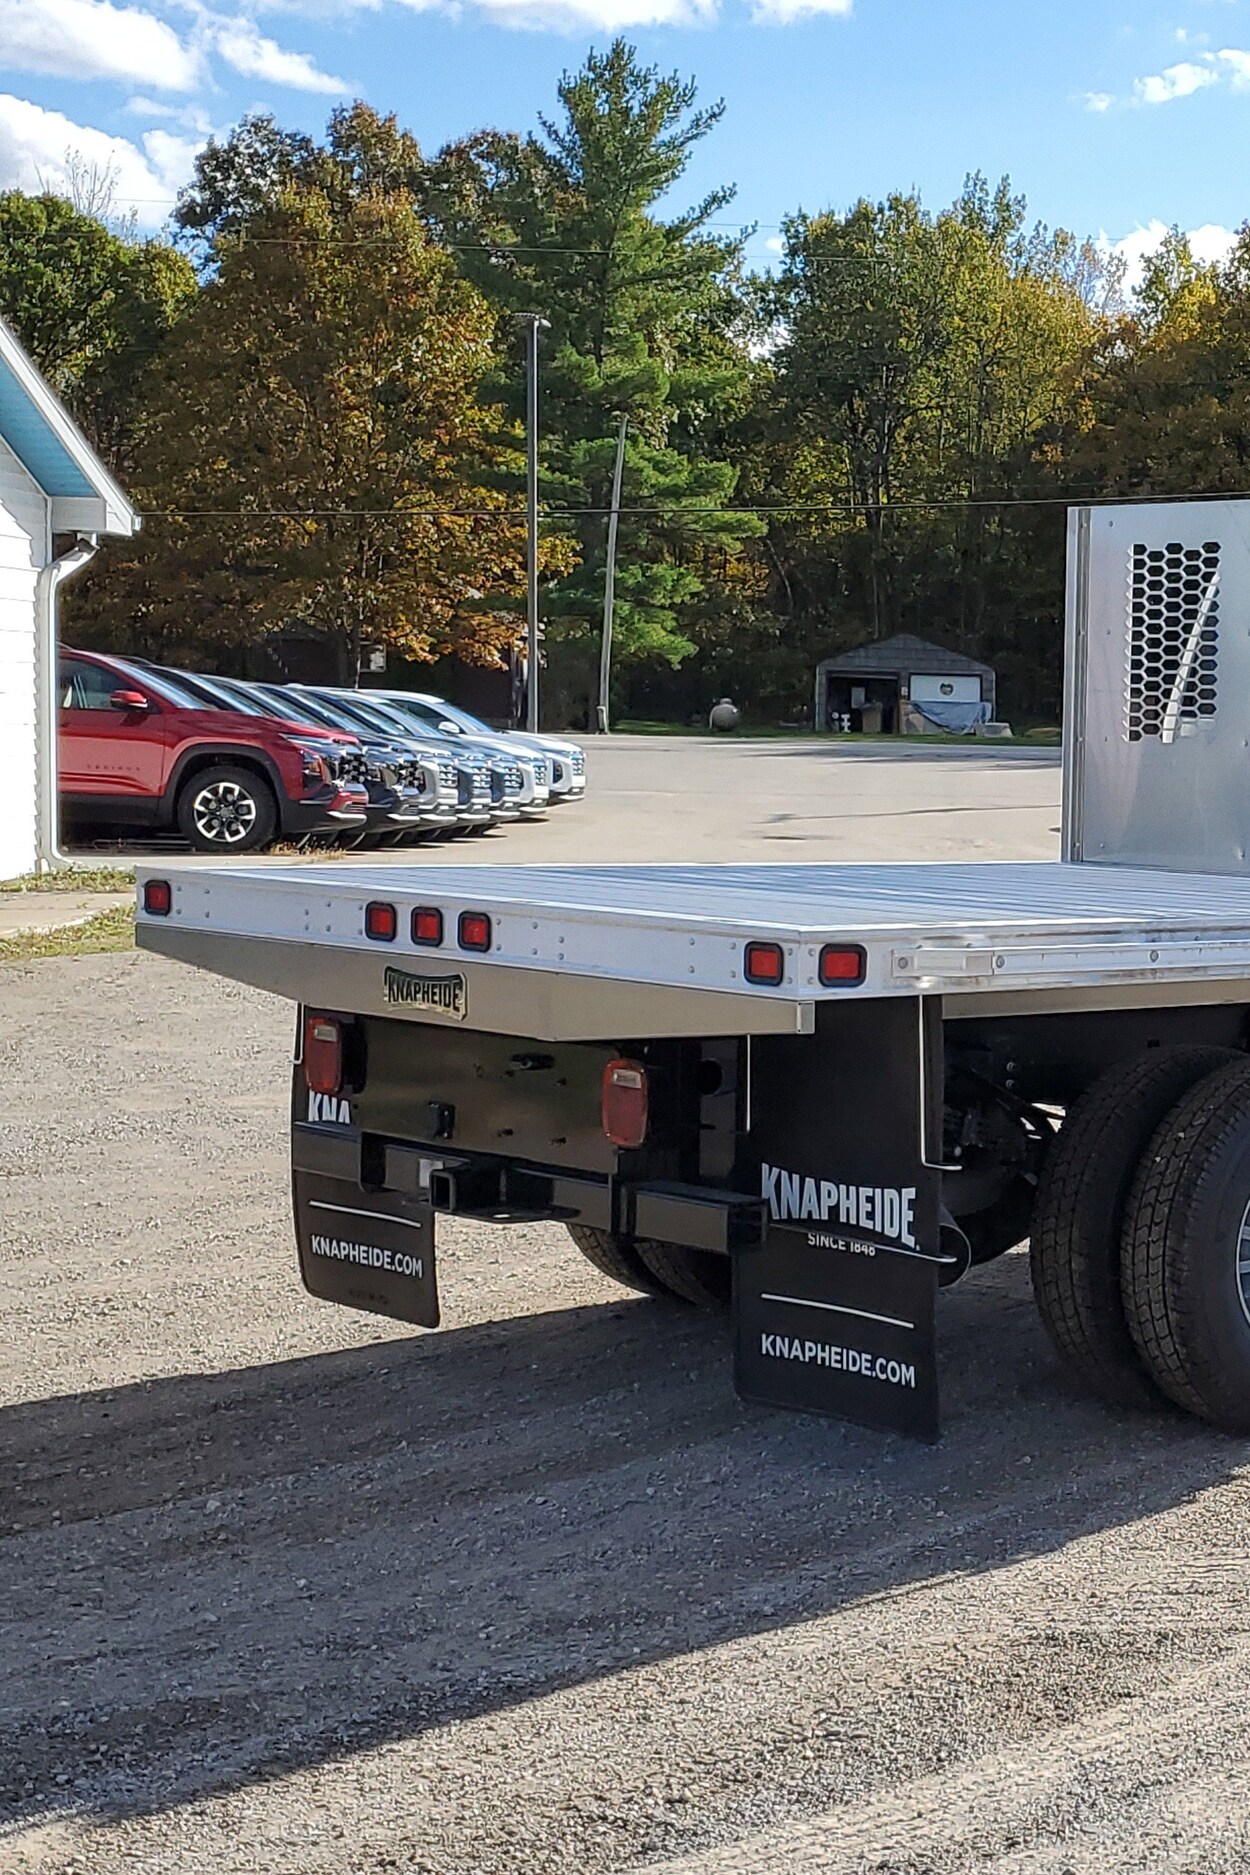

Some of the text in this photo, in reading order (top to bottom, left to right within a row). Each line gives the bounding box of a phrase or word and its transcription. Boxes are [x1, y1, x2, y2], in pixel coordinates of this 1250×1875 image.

[387, 972, 461, 1013] KNAPHEIDE
[761, 1162, 916, 1249] KNAPHEIDE
[311, 1234, 423, 1278] KNAPHEIDE.COM
[807, 1232, 847, 1251] SINCE
[761, 1333, 917, 1389] KNAPHEIDE.COM
